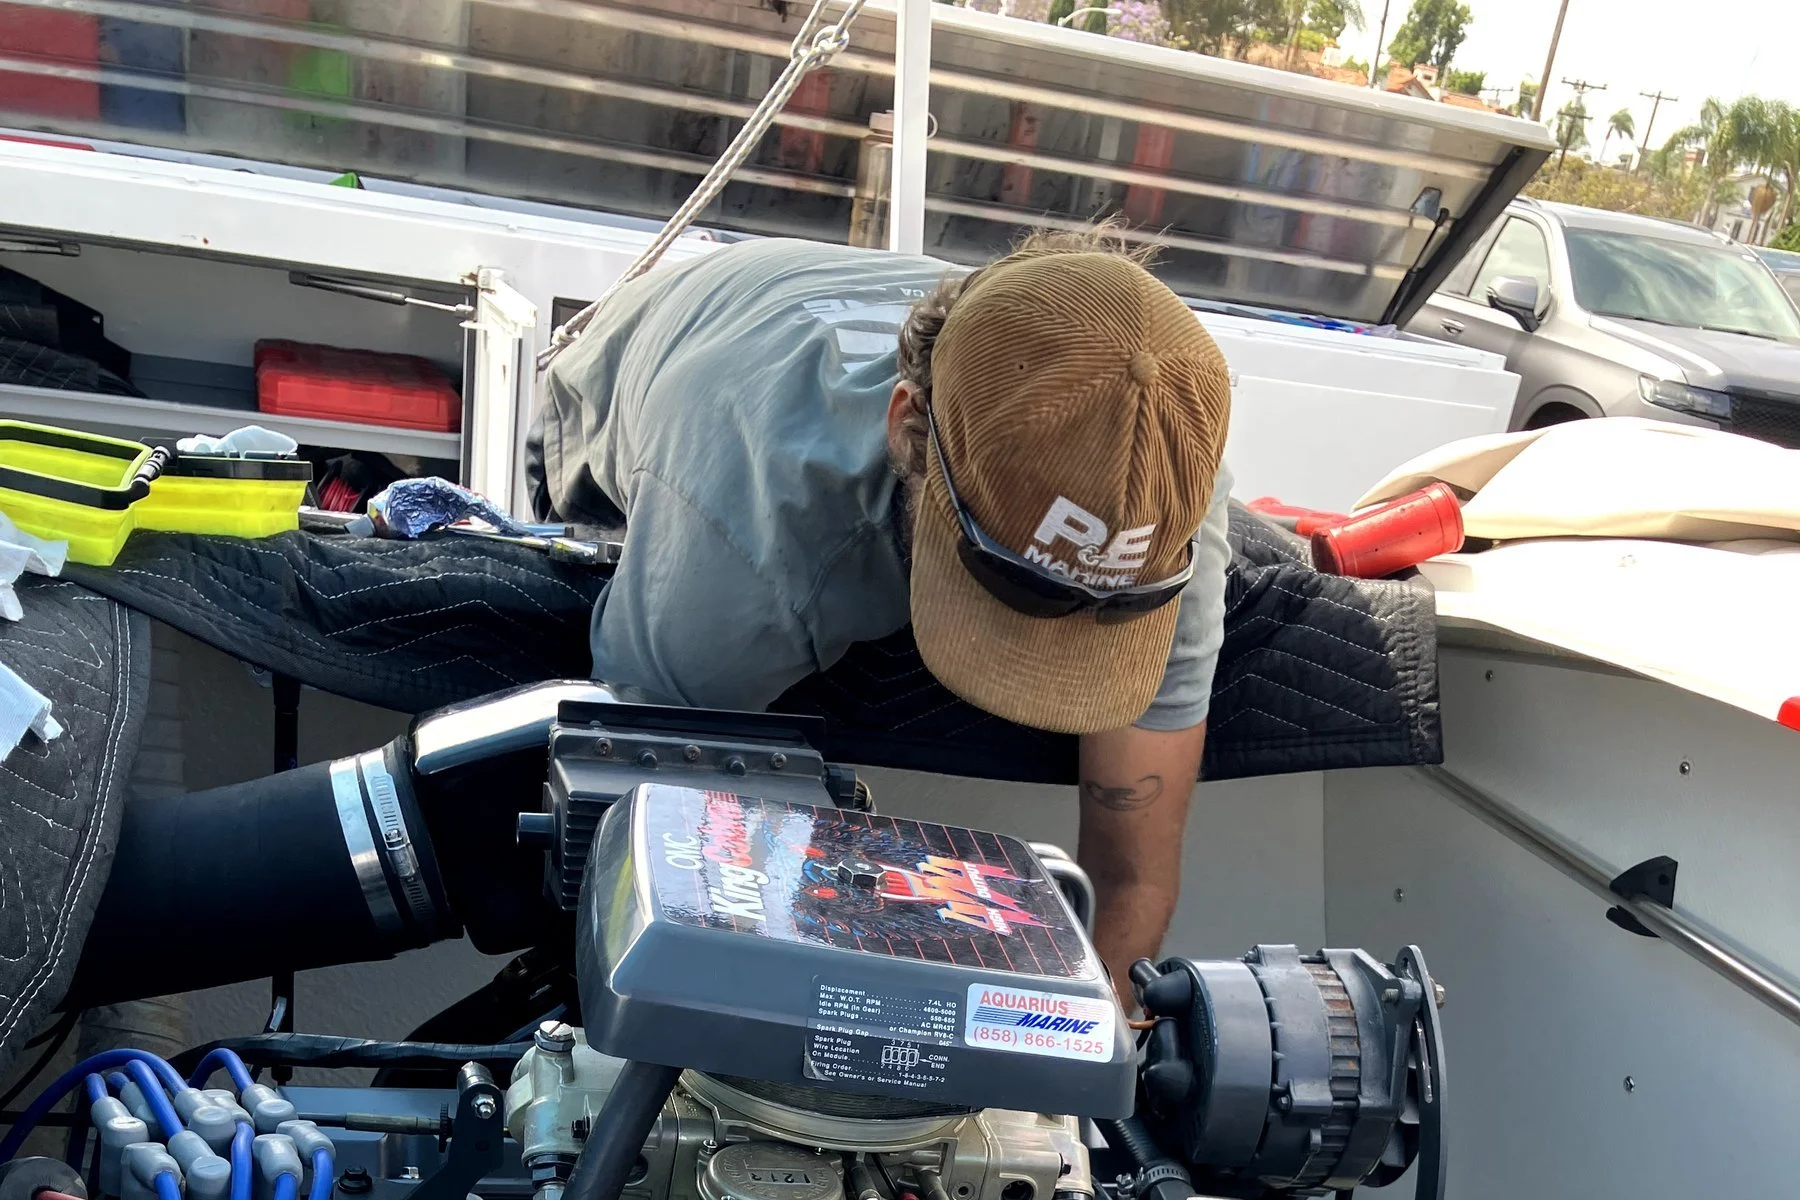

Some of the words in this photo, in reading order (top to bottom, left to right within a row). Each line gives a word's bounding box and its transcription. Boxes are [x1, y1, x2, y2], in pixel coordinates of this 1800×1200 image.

[662, 832, 704, 870] OMC
[819, 992, 836, 1000] Max.
[840, 994, 862, 1003] W.O.T.
[866, 998, 881, 1006] RPM
[820, 984, 866, 996] Displacement
[928, 999, 942, 1007] 7.4L
[946, 1001, 957, 1009] HO
[980, 991, 1069, 1015] AQUARIUS
[819, 1000, 832, 1008] Idle
[834, 1002, 849, 1010] RPM
[862, 1006, 881, 1015] Gear)
[818, 1008, 838, 1017] Spark
[840, 1011, 859, 1020] Plugs
[920, 1021, 932, 1029] AC
[1016, 1013, 1099, 1034] MARINE
[816, 1023, 836, 1032] Spark
[837, 1026, 854, 1036] Plug
[855, 1028, 870, 1037] Gap
[898, 1026, 932, 1037] Champion
[814, 1034, 834, 1043] Spark
[836, 1037, 852, 1047] Plug
[974, 1026, 1018, 1046] (858)
[1024, 1033, 1104, 1054] 866-1525
[813, 1042, 829, 1051] Wire
[830, 1045, 860, 1055] Location
[823, 1052, 849, 1061] Module
[810, 1060, 831, 1070] Firing
[832, 1063, 852, 1071] Order
[930, 1062, 945, 1070] END
[838, 1071, 866, 1081] Owner's
[876, 1076, 902, 1085] Service
[903, 1080, 928, 1088] Manual
